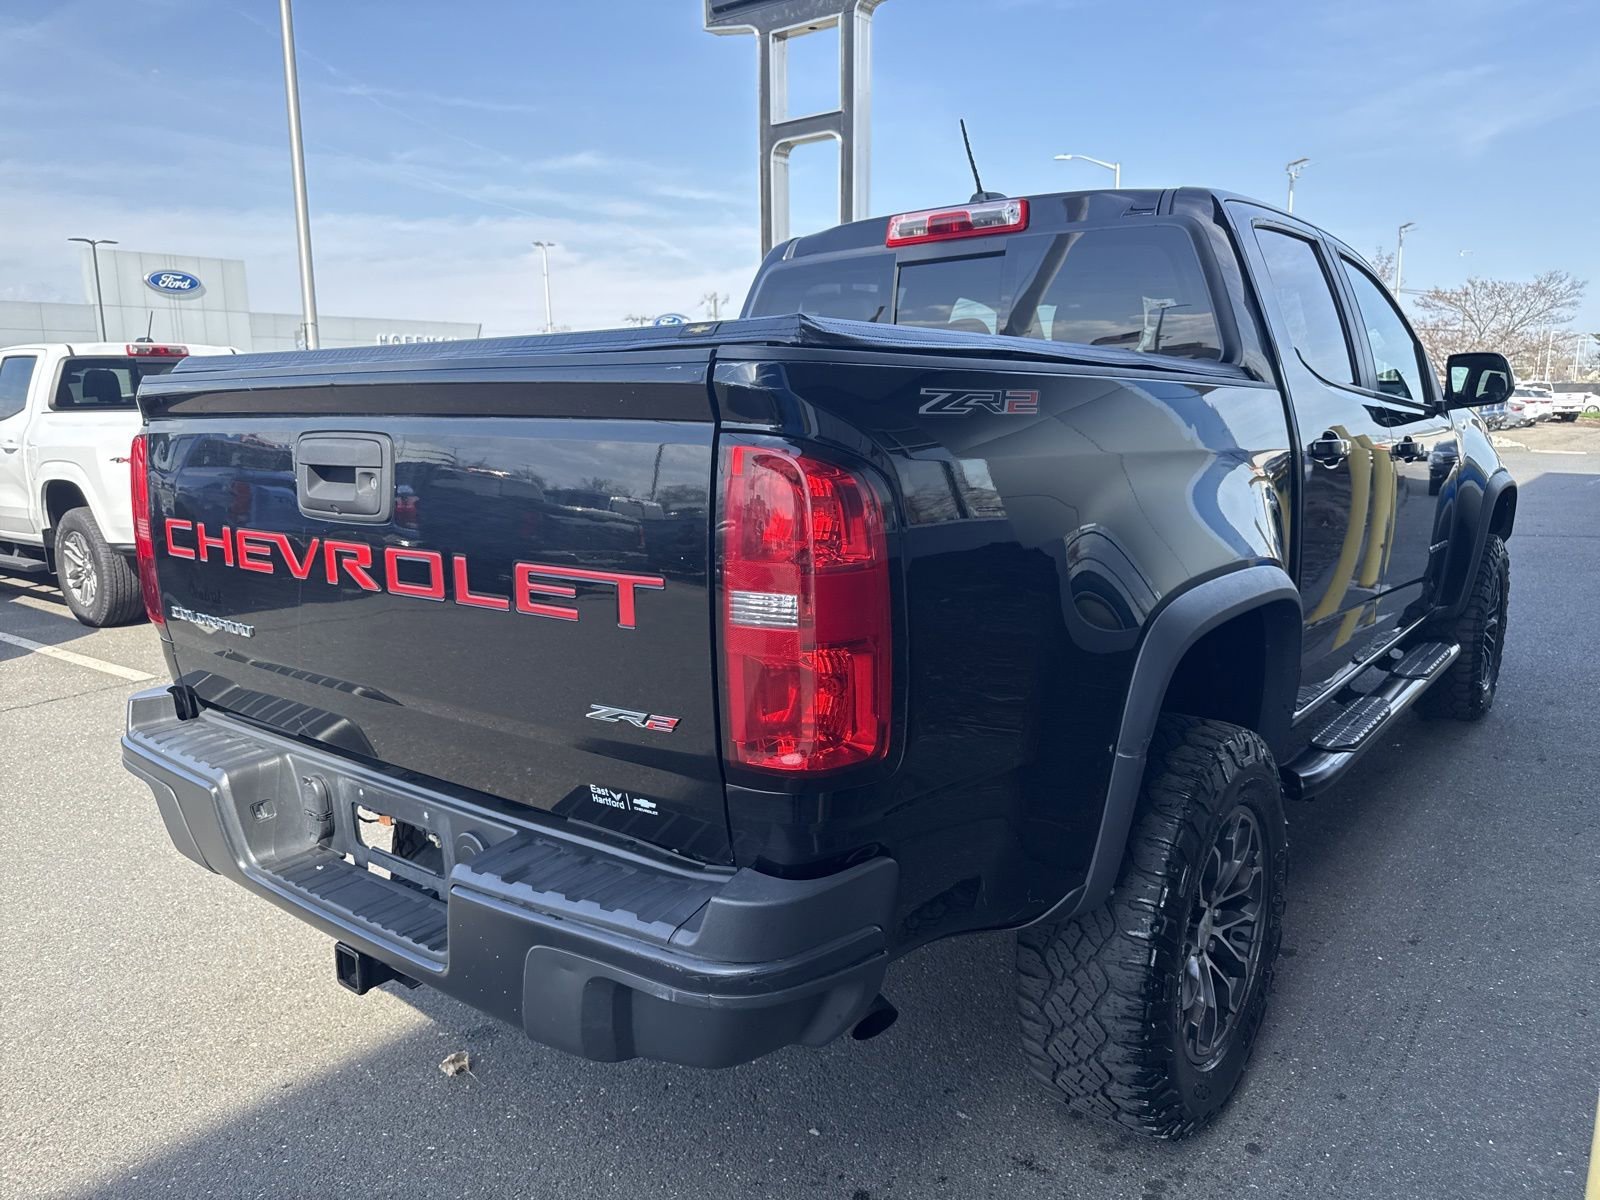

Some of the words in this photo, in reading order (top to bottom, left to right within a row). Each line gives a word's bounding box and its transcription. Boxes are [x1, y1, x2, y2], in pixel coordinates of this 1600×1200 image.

[158, 274, 191, 290] Ford
[918, 387, 1039, 415] ZR2
[164, 517, 666, 630] CHEVROLET
[171, 605, 255, 638] COLORADO
[585, 703, 682, 733] ZR2
[589, 783, 610, 797] East
[591, 793, 626, 810] Hartford
